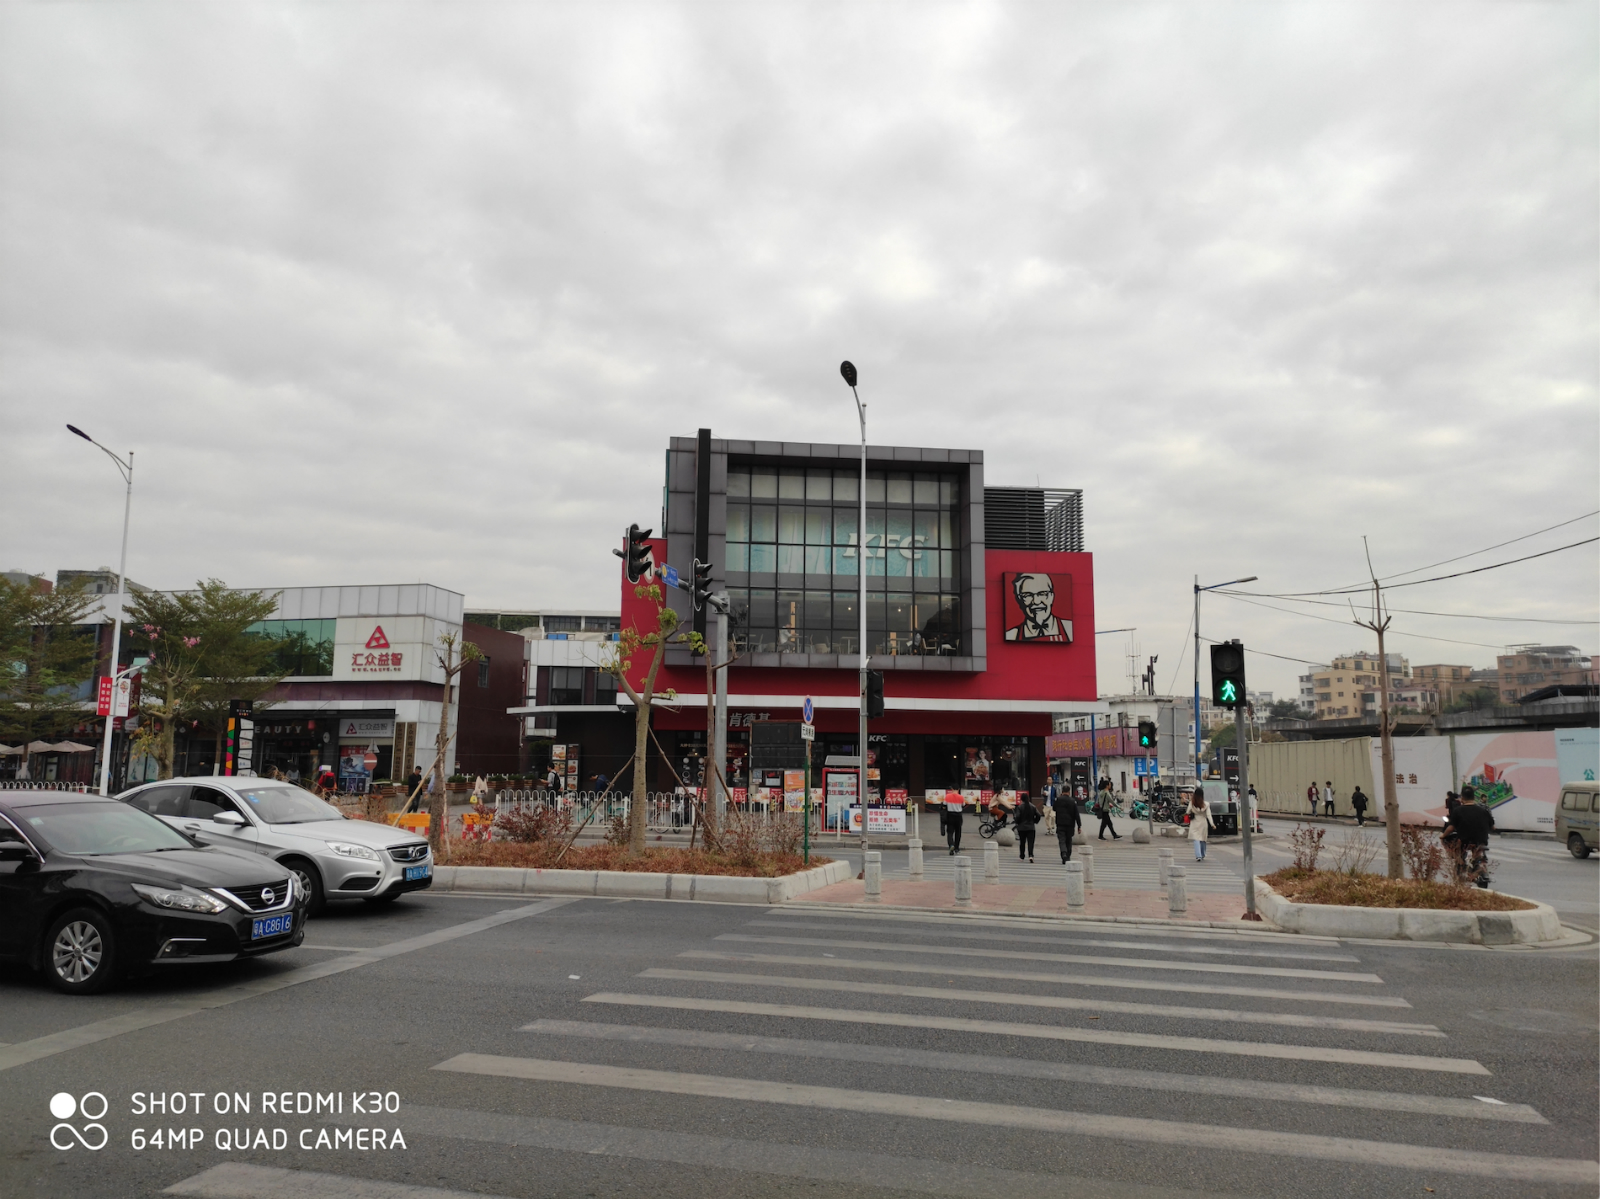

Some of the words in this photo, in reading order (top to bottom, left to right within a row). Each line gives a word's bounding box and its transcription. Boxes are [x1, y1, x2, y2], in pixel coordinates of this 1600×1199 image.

[842, 533, 925, 559] KFC
[351, 652, 403, 666] 汇众益智
[358, 723, 388, 731] 汇众益智
